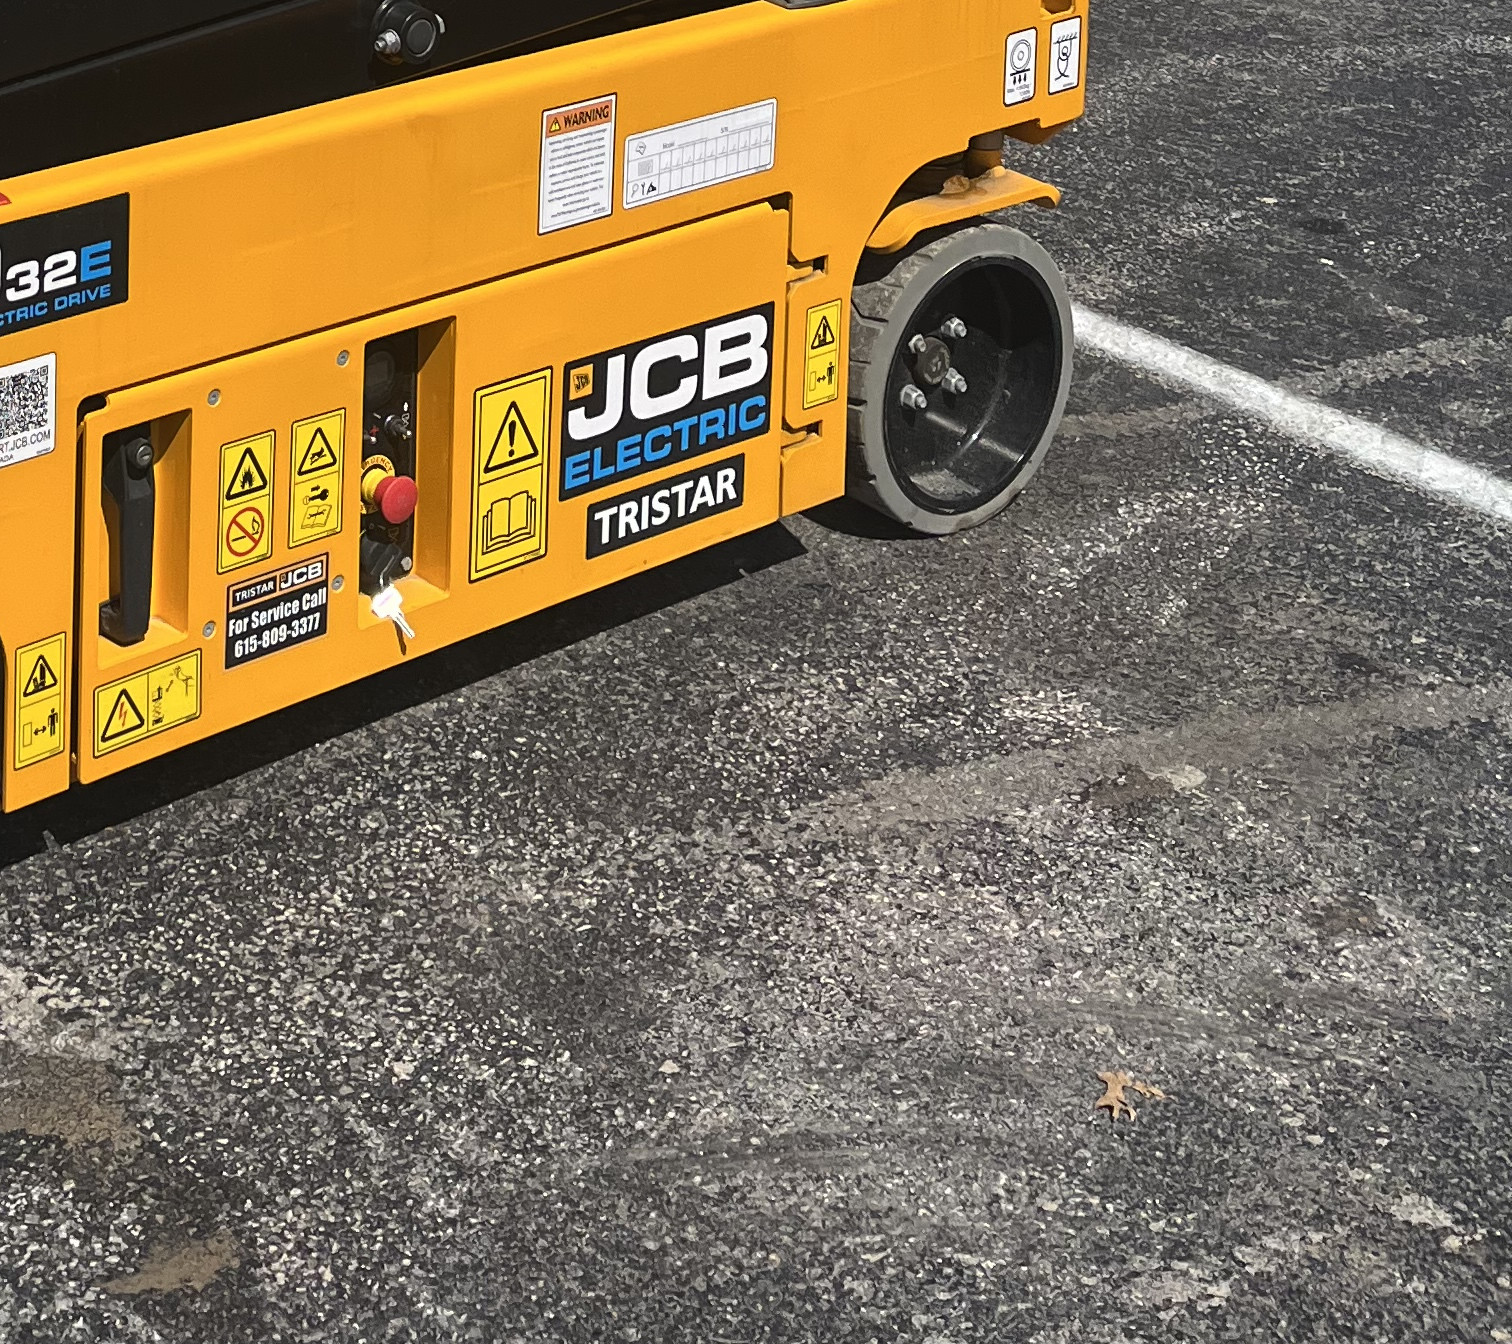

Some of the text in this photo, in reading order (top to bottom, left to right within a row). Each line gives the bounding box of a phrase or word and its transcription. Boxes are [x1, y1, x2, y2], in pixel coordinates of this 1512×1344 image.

[563, 105, 610, 129] WARNING
[55, 283, 112, 312] DRIVE
[567, 314, 768, 441] JCB
[564, 395, 767, 490] ELECTRIC
[594, 467, 738, 545] TRISTAR
[235, 562, 323, 602] TRISTAR JCB
[228, 587, 327, 638] For Service Call
[234, 612, 321, 658] 615-809-3377
